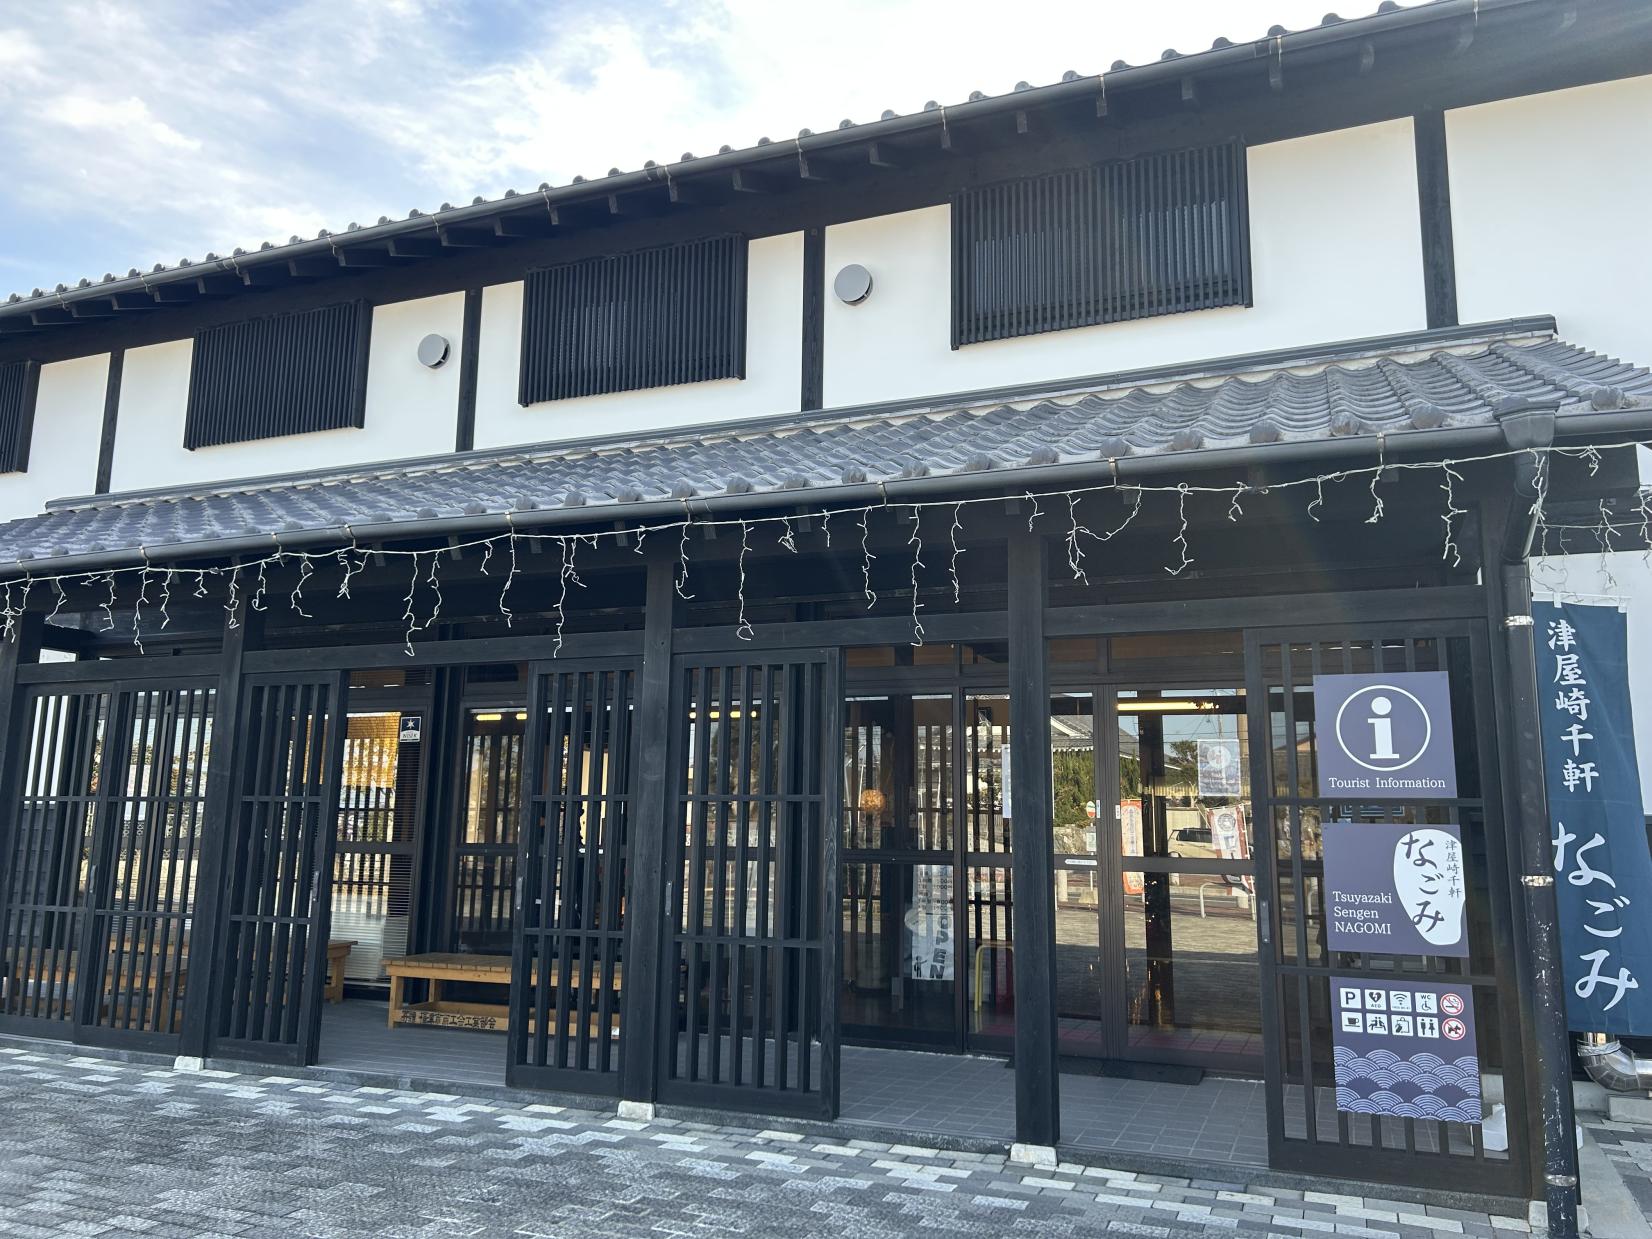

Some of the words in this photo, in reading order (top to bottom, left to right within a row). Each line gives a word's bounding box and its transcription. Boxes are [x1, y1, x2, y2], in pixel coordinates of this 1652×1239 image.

[1547, 619, 1599, 793] 津屋崎千軒
[1328, 777, 1370, 788] Tourist
[1375, 777, 1446, 788] Information
[1400, 832, 1445, 932] なごみ
[1445, 839, 1462, 899] 津屋崎千軒
[1332, 890, 1393, 904] Tsuyazaki
[1333, 906, 1379, 920] Sengen
[1334, 922, 1392, 935] NAGOMI
[1552, 821, 1639, 1011] なごみ
[929, 915, 952, 979] OPEN
[1345, 991, 1356, 1005] P
